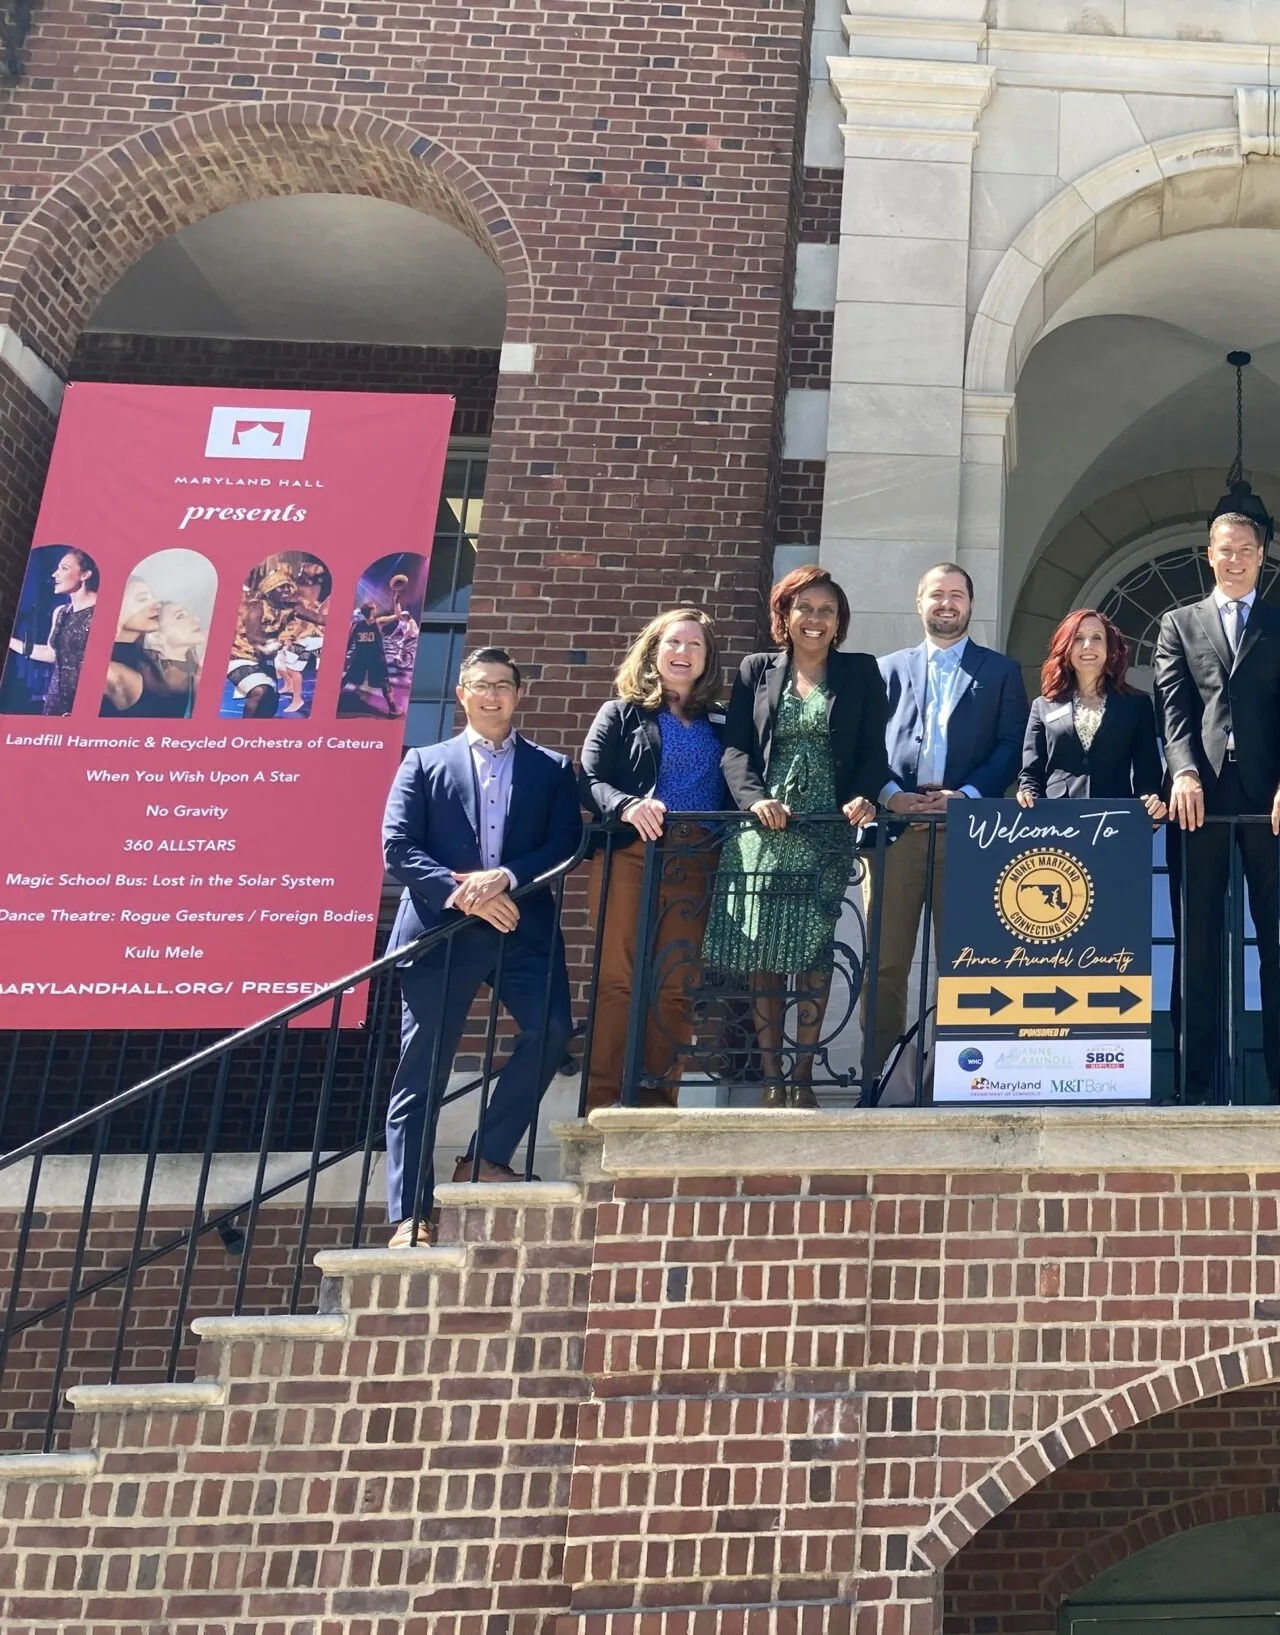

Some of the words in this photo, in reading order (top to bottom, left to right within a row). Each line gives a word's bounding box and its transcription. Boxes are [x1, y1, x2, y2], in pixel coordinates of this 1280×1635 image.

[174, 476, 271, 487] MARYLAND
[279, 478, 324, 488] HALL
[178, 503, 307, 529] presents
[6, 734, 62, 747] Landfill
[67, 736, 140, 749] Harmonic
[144, 737, 156, 749] &
[161, 737, 227, 751] Recycled
[231, 737, 303, 749] Orchestra
[307, 737, 325, 749] of
[326, 738, 384, 749] Cateura
[86, 770, 129, 782] When
[135, 771, 164, 782] You
[169, 771, 205, 782] Wish
[209, 771, 249, 784] Upon
[253, 771, 265, 782] A
[269, 771, 300, 782] Star
[146, 805, 169, 817] No
[173, 805, 228, 820] Gravity
[968, 811, 1080, 849] Welcome
[1079, 811, 1131, 846] To
[123, 839, 153, 852] 360
[157, 840, 236, 852] ALLSTARS
[1009, 859, 1037, 883] MONEY
[1038, 856, 1081, 883] MARYLAND
[5, 874, 54, 888] Magic
[58, 874, 110, 887] School
[115, 875, 147, 887] Bus:
[152, 875, 185, 887] Lost
[190, 876, 203, 887] in
[207, 875, 233, 887] the
[238, 875, 276, 887] Solar
[280, 875, 335, 890] System
[0, 909, 45, 921] Dance
[51, 909, 115, 921] Theatre:
[120, 910, 171, 925] Rogue
[175, 910, 244, 922] Gestures
[248, 910, 256, 922] /
[260, 910, 319, 925] Foreign
[323, 911, 374, 923] Bodies
[1010, 911, 1061, 936] CONNECTING
[1061, 911, 1078, 928] YOU
[124, 946, 160, 959] Kulu
[164, 946, 204, 959] Mele
[951, 946, 1001, 970] Anne
[1004, 946, 1073, 970] Arundel
[1077, 946, 1135, 973] County
[241, 981, 355, 994] PRESEN
[1018, 1028, 1059, 1038] SPONSORED
[1059, 1028, 1070, 1037] BY
[1086, 1052, 1125, 1063] SBDC
[990, 1080, 1042, 1092] Maryland
[1051, 1079, 1084, 1093] M&T
[1085, 1079, 1118, 1093] Bank
